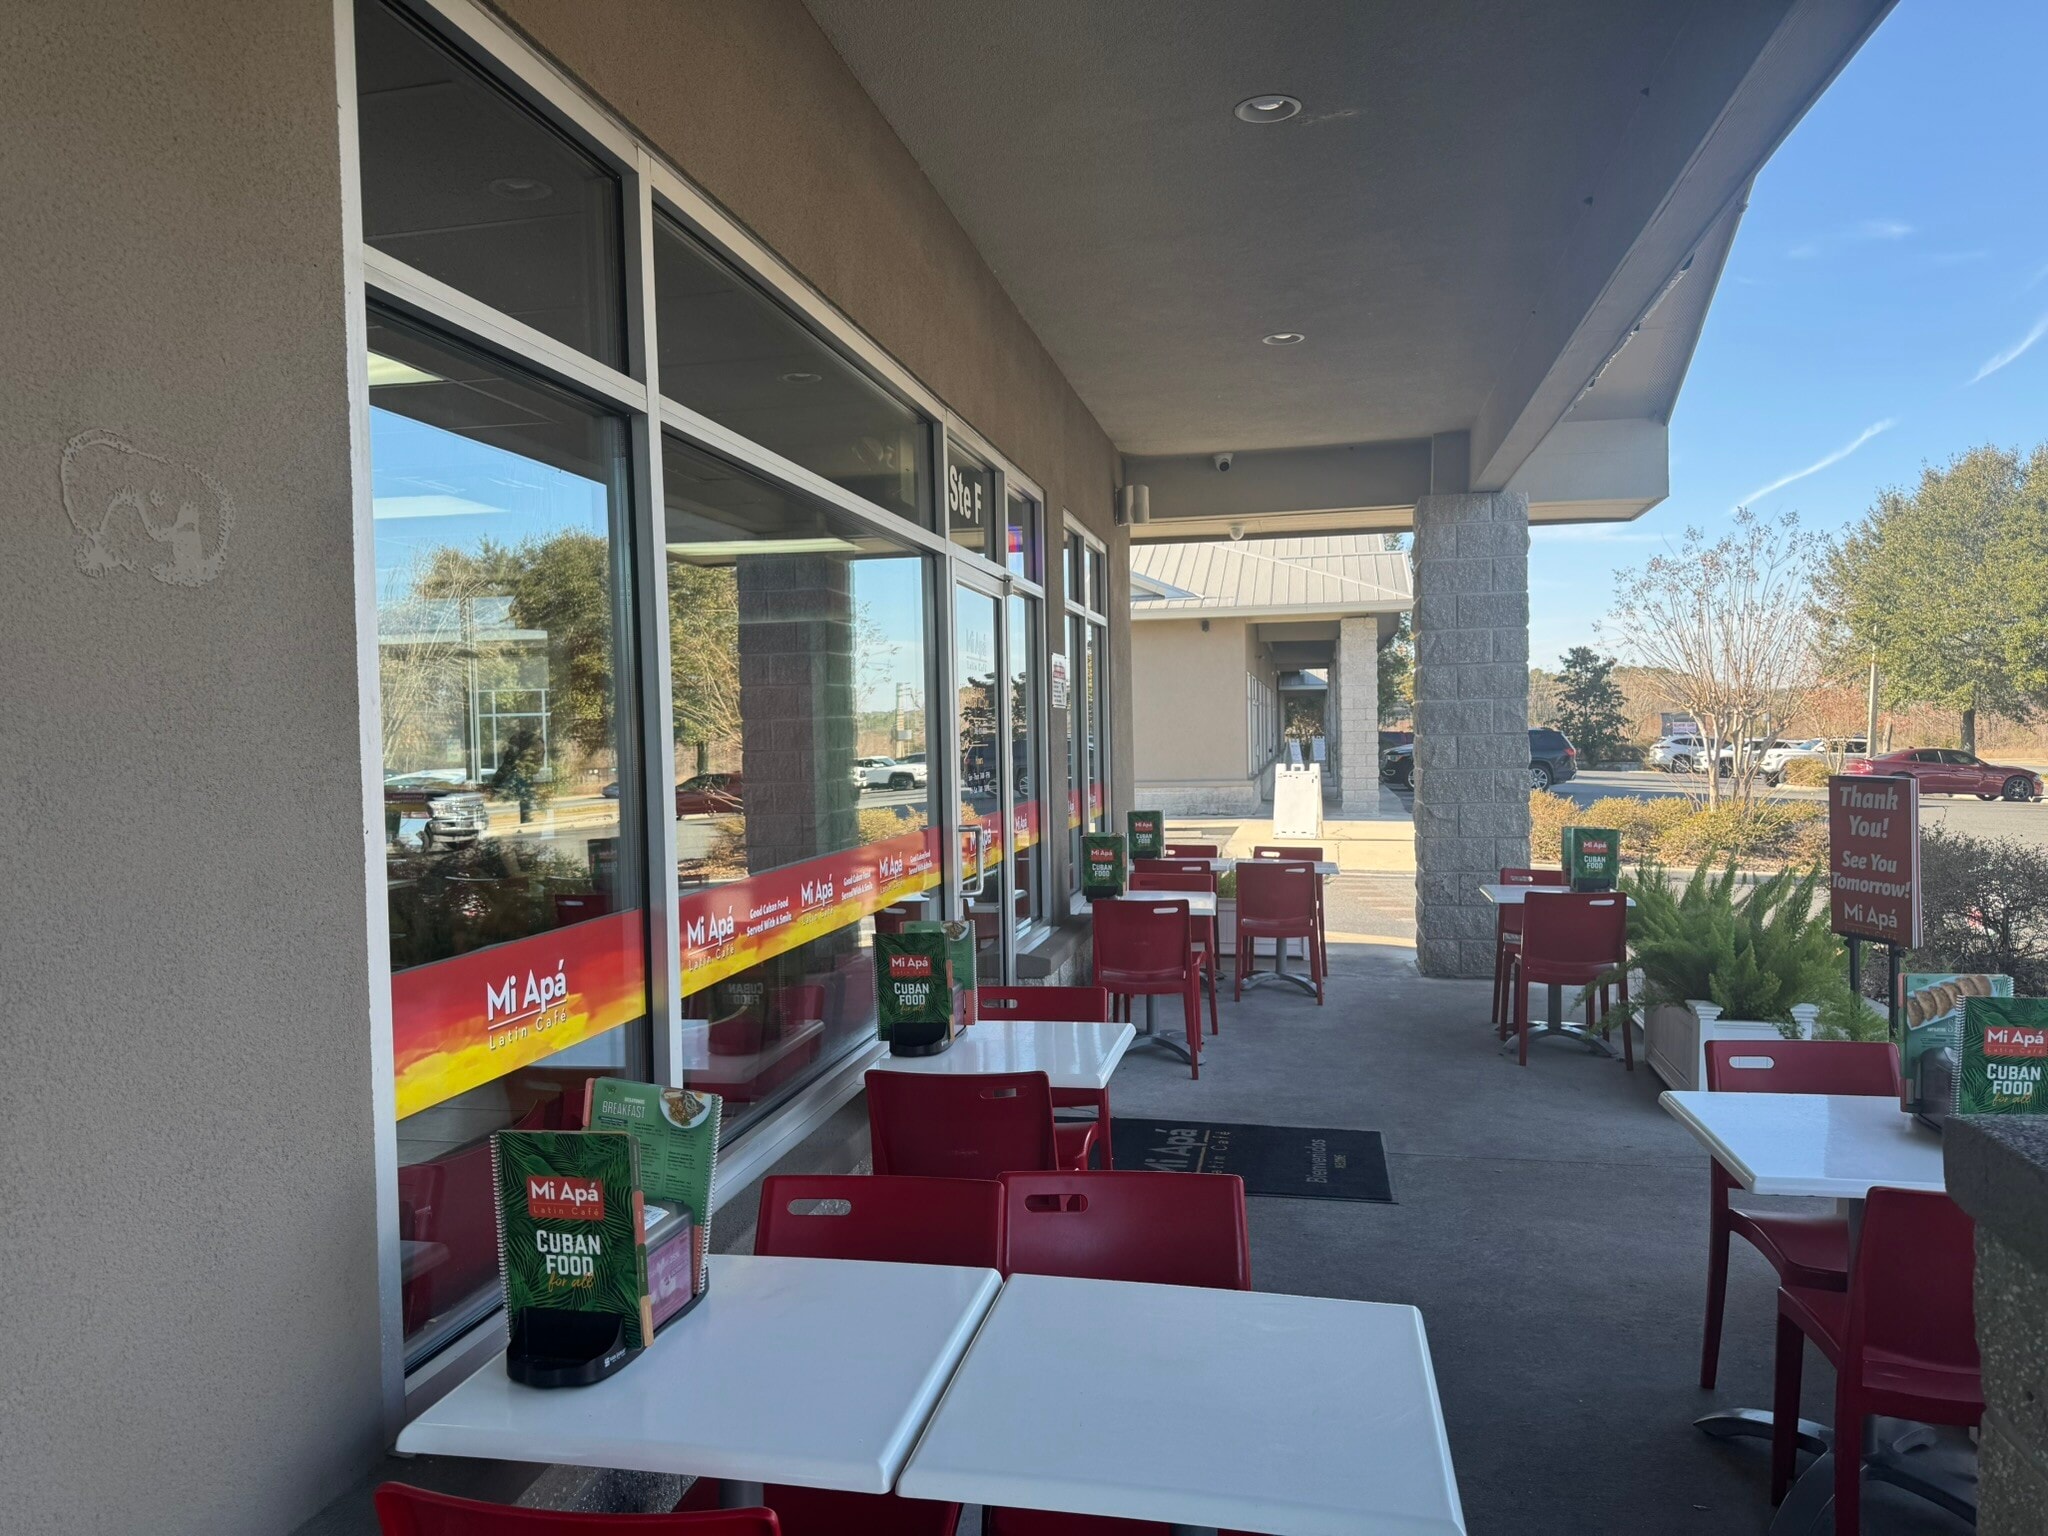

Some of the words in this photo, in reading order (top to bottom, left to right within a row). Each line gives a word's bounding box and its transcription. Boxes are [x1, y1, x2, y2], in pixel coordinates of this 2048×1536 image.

[950, 464, 971, 520] Ste
[974, 482, 982, 524] F
[1840, 784, 1898, 810] Thank
[1849, 815, 1890, 839] You!
[1594, 841, 1607, 849] Apá
[879, 856, 888, 879] Mi
[890, 852, 903, 880] Apá
[1092, 863, 1112, 871] CUBAN
[1584, 855, 1606, 863] CUBAN
[1842, 850, 1867, 869] See
[1870, 853, 1897, 873] You
[801, 880, 813, 907] Mi
[815, 874, 833, 906] Apá
[1832, 871, 1912, 899] Tomorrow!
[750, 904, 762, 919] Good
[763, 902, 777, 915] Cuban
[778, 896, 788, 909] Food
[1844, 902, 1862, 922] Mi
[1866, 906, 1898, 931] Apá
[687, 916, 704, 949] Mi
[708, 905, 734, 946] Apá
[747, 920, 763, 937] Served
[764, 916, 776, 930] With
[780, 910, 792, 924] Smile
[689, 956, 712, 971] Latin
[716, 943, 735, 960] Café
[892, 957, 905, 968] Mi
[907, 956, 928, 970] Apá
[487, 974, 517, 1021] Mi
[522, 958, 567, 1012] Apá
[894, 982, 930, 995] CUBAN
[900, 994, 926, 1006] FOOD
[489, 1026, 528, 1050] Latin
[536, 1008, 567, 1031] Café
[1988, 1029, 2008, 1043] Mi
[2012, 1030, 2044, 1048] Apá
[1987, 1063, 2041, 1081] CUBAN
[1992, 1093, 2010, 1106] for
[2013, 1092, 2032, 1104] all
[1993, 1080, 2033, 1095] FOOD
[602, 1100, 646, 1119] BREAKFAST
[1147, 1128, 1208, 1156] Apá
[1208, 1156, 1226, 1174] atin
[1304, 1139, 1328, 1184] Bienvenidos
[530, 1180, 556, 1200] Mi
[560, 1182, 599, 1206] Apá
[533, 1206, 564, 1215] Latin
[572, 1208, 599, 1216] Café
[536, 1230, 600, 1256] CUBAN
[546, 1254, 594, 1276] FOOD
[548, 1271, 566, 1293] for
[571, 1272, 594, 1288] all
